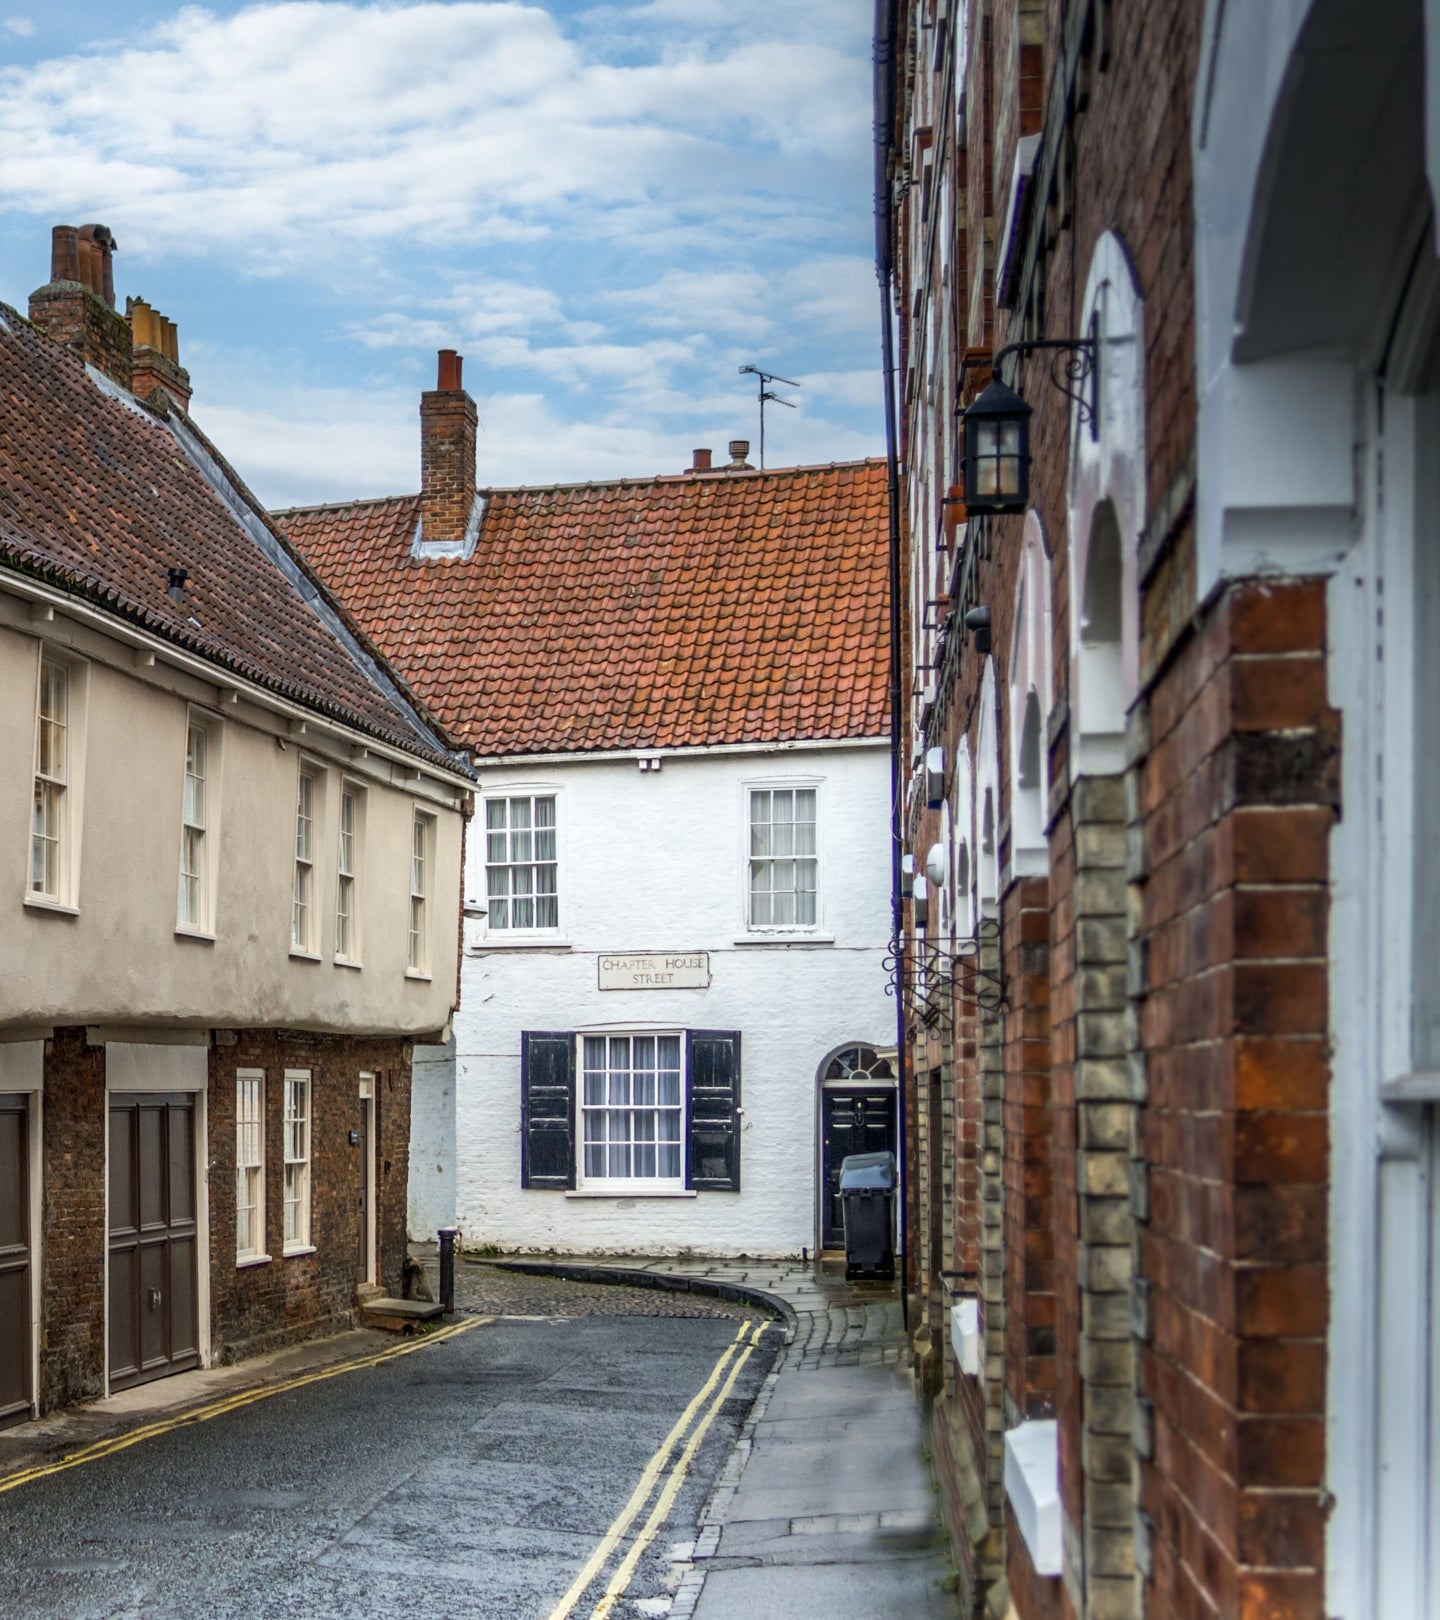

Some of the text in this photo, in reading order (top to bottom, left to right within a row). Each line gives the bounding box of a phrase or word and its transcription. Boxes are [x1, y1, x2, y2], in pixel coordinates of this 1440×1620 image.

[602, 957, 704, 971] CHAPTER HOUSE
[632, 973, 674, 984] STREET
